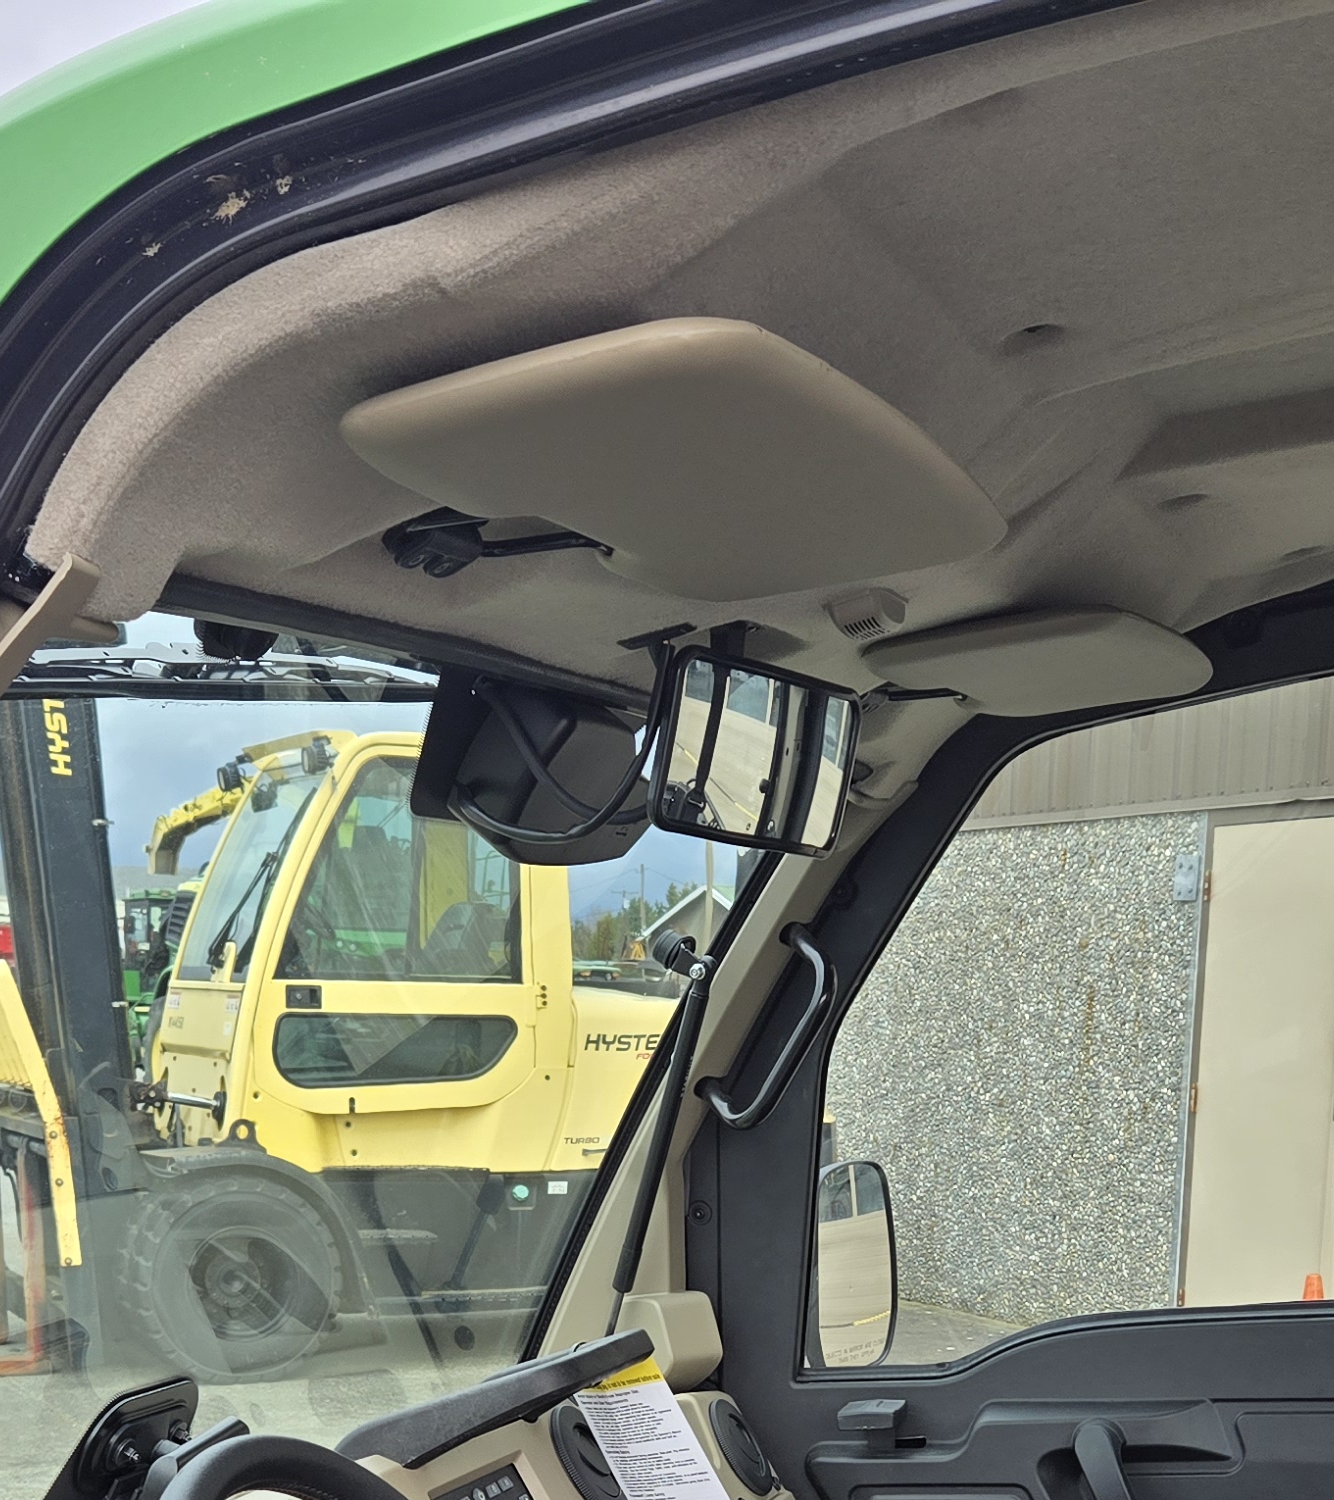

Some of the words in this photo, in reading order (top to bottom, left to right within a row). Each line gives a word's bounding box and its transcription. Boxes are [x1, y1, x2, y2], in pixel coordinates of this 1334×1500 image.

[42, 699, 72, 776] HYST
[584, 1033, 660, 1052] HYSTE
[563, 1137, 600, 1145] TURBO
